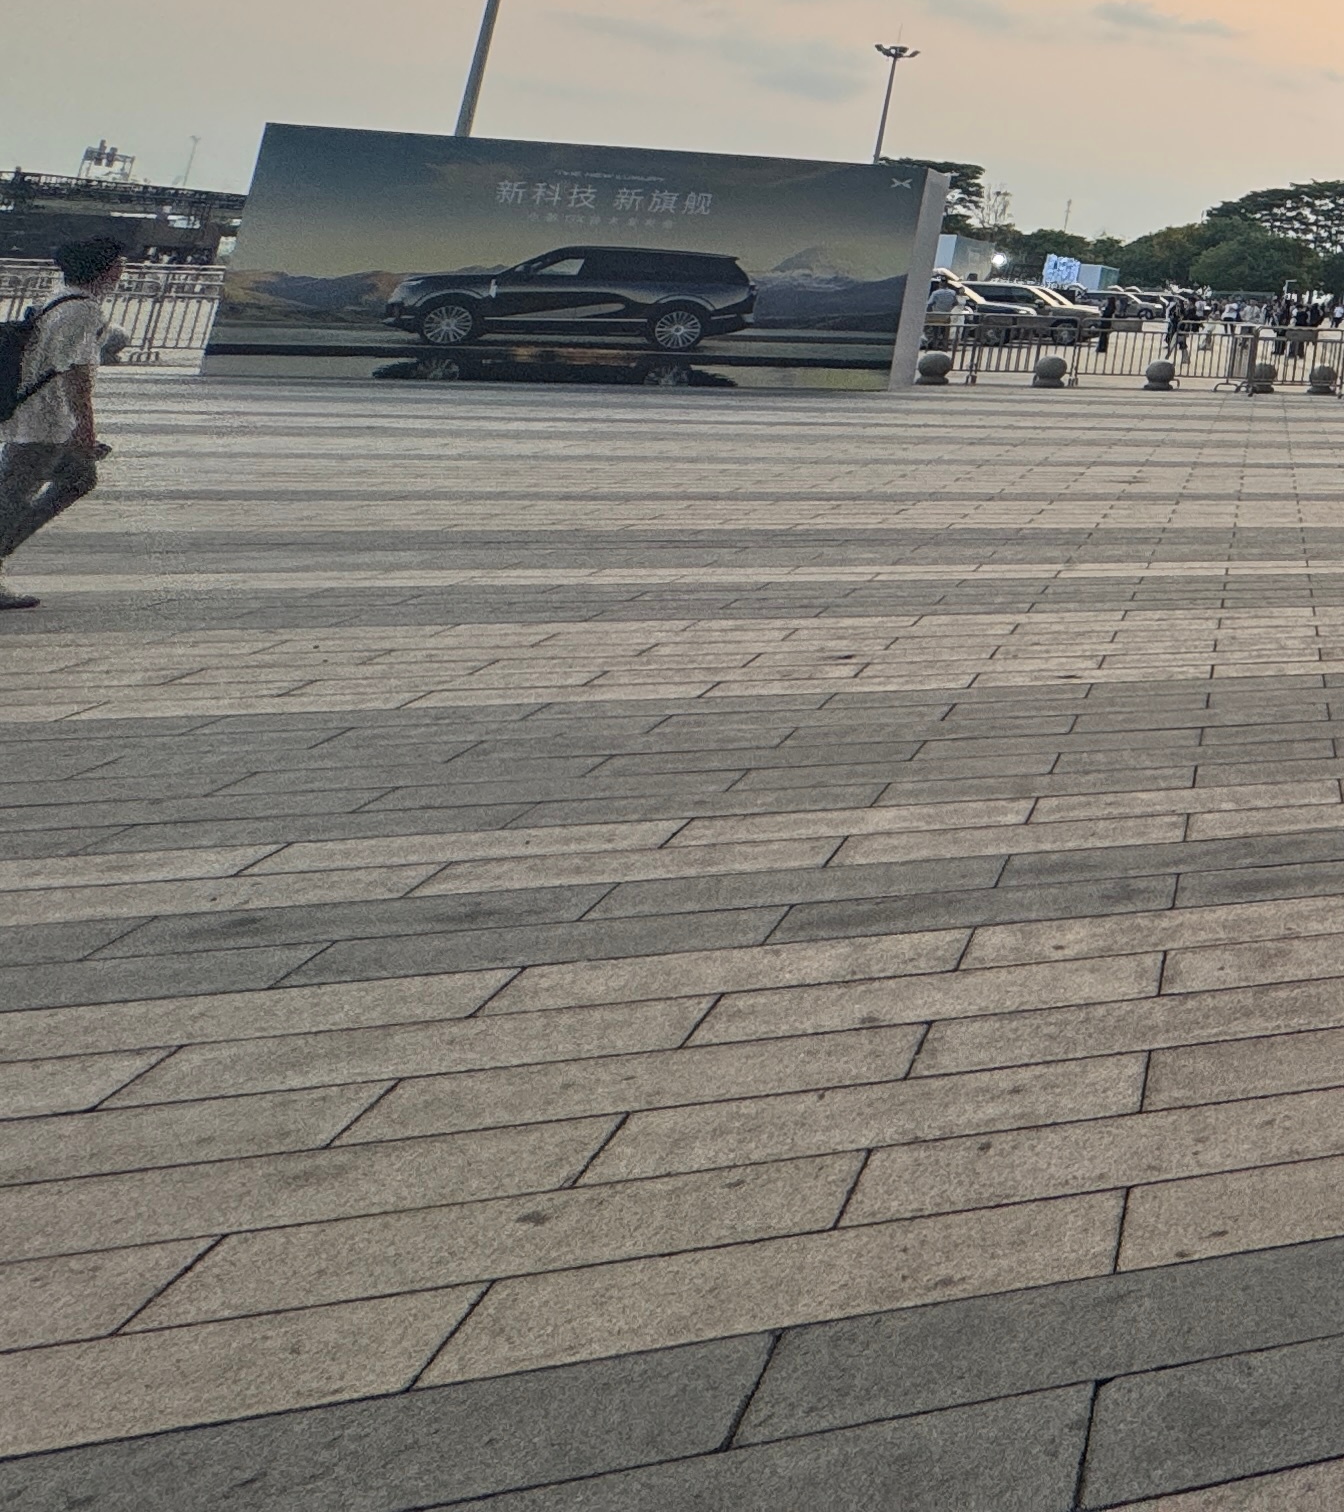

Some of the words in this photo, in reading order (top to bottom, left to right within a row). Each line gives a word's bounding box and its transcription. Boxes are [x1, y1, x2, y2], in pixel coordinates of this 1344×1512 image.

[495, 179, 598, 210] 新科技
[612, 187, 713, 216] 新旗舰
